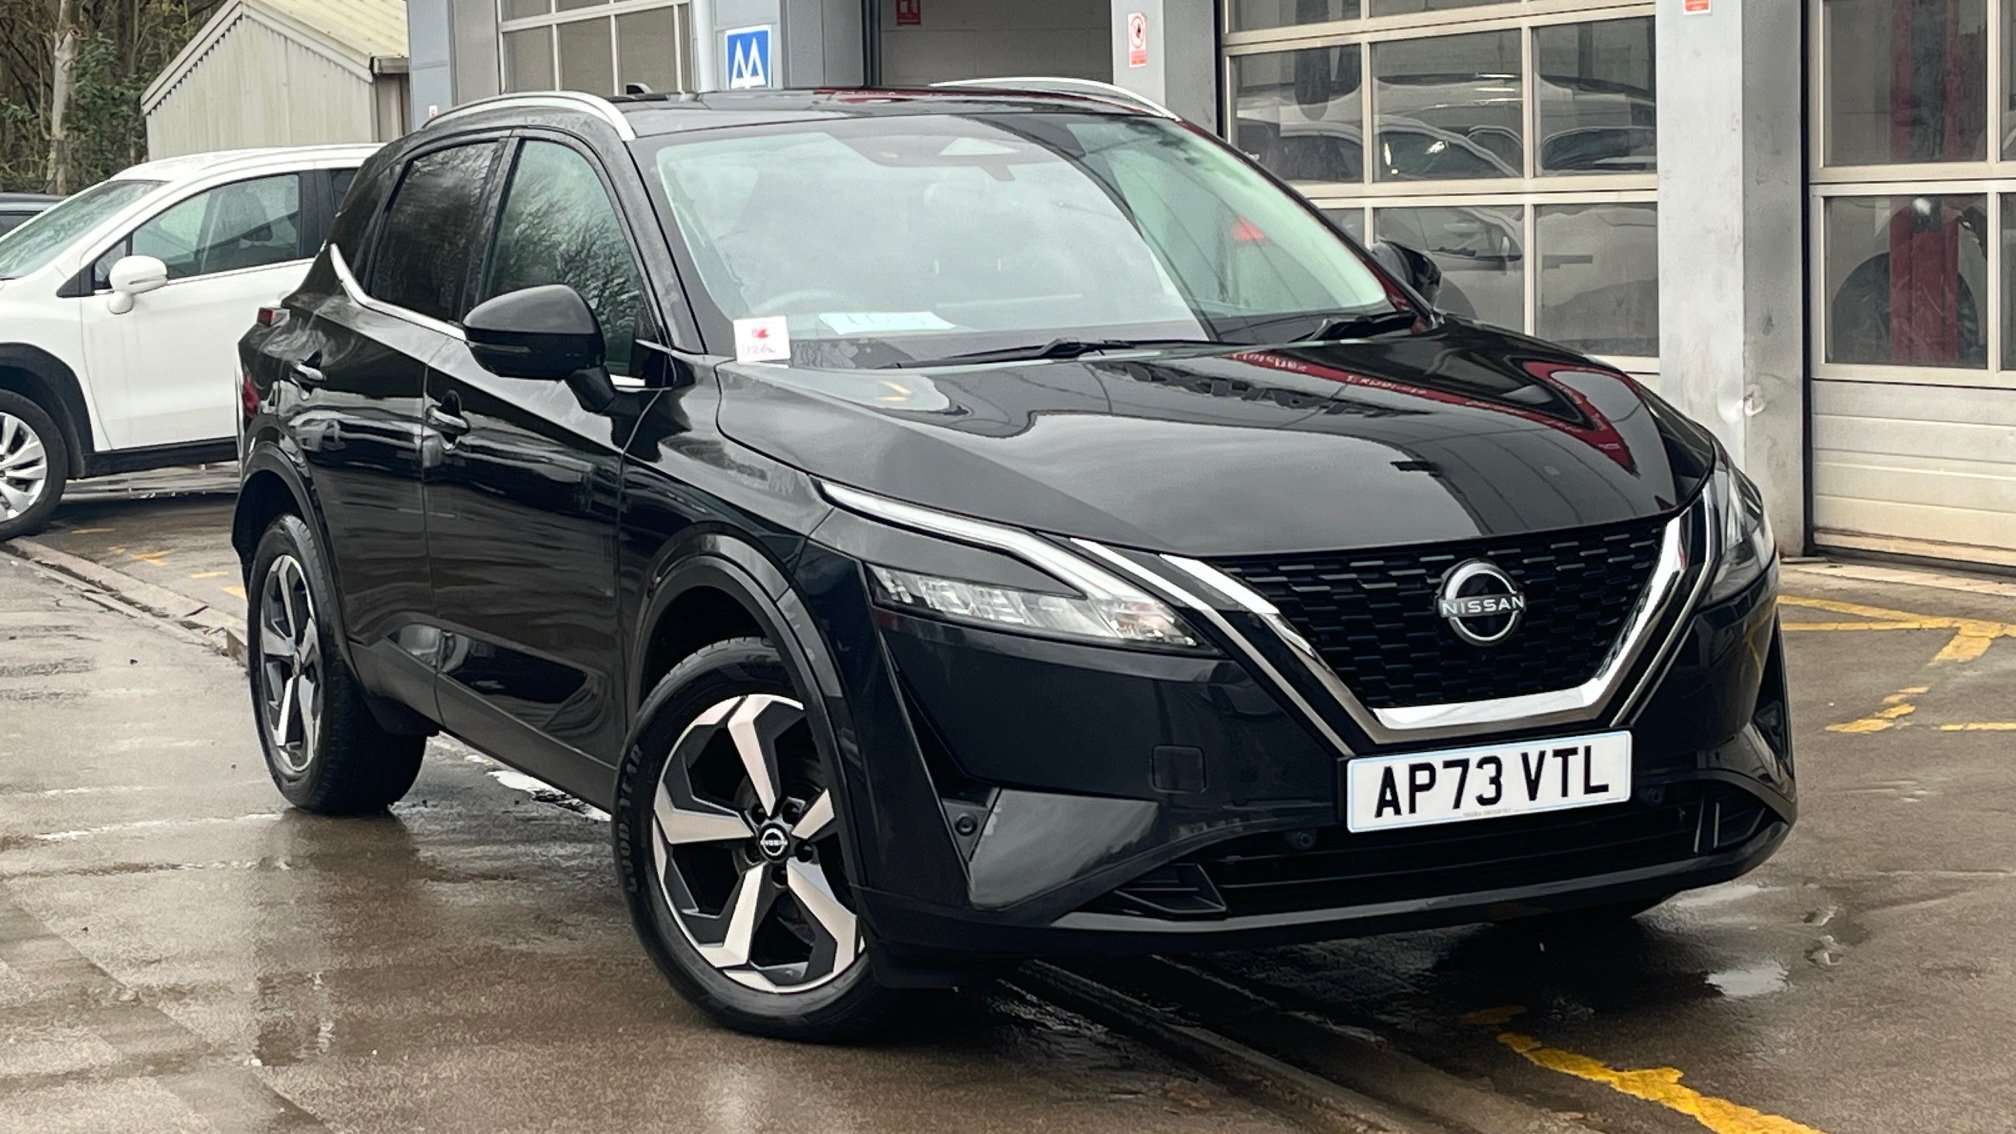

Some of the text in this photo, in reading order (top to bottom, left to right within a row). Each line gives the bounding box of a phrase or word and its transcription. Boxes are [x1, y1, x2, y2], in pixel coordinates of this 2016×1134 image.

[1442, 595, 1524, 615] NISSAN
[1374, 745, 1609, 818] AP73 VTL
